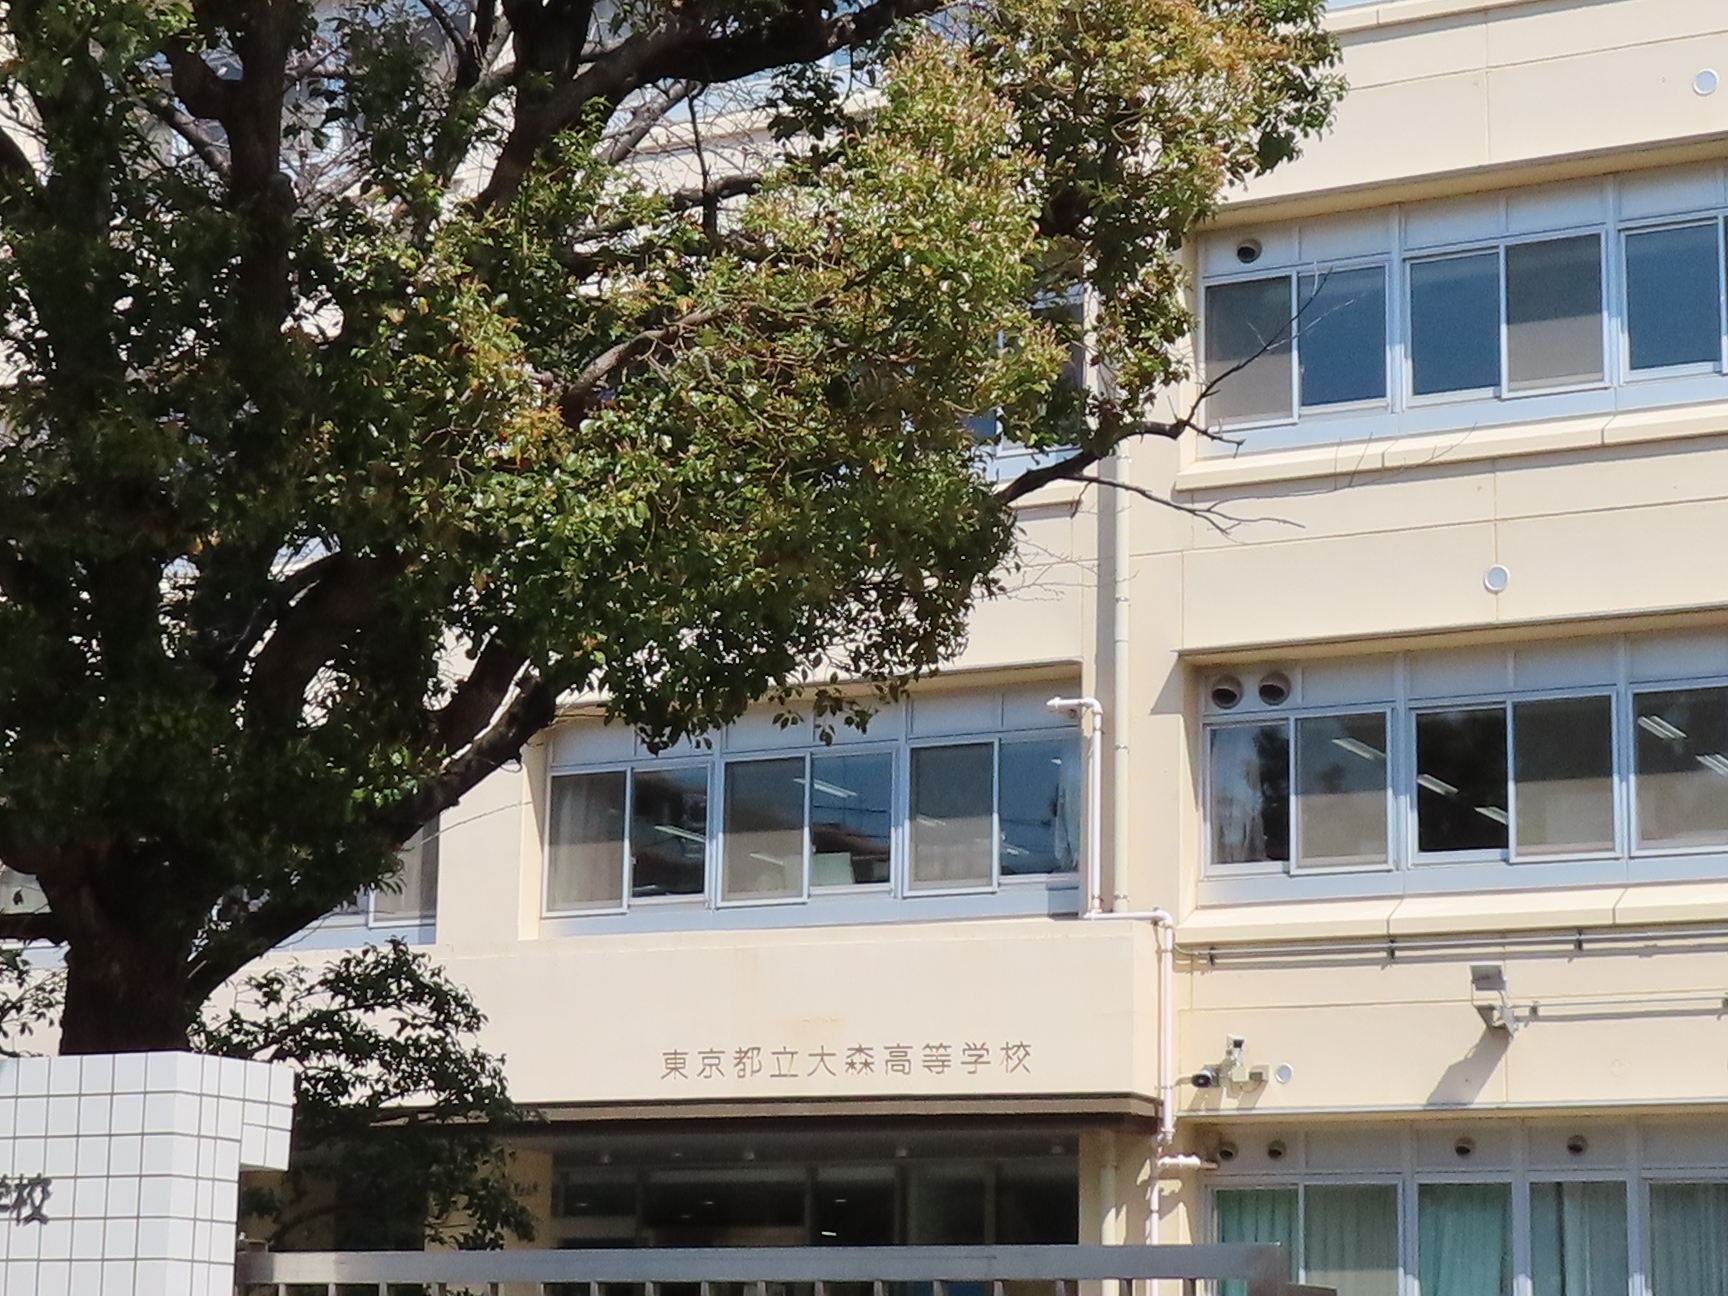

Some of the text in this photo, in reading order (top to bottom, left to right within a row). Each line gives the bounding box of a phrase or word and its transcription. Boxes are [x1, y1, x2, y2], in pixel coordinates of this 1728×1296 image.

[660, 1041, 1032, 1080] 東京都立大森高等学校
